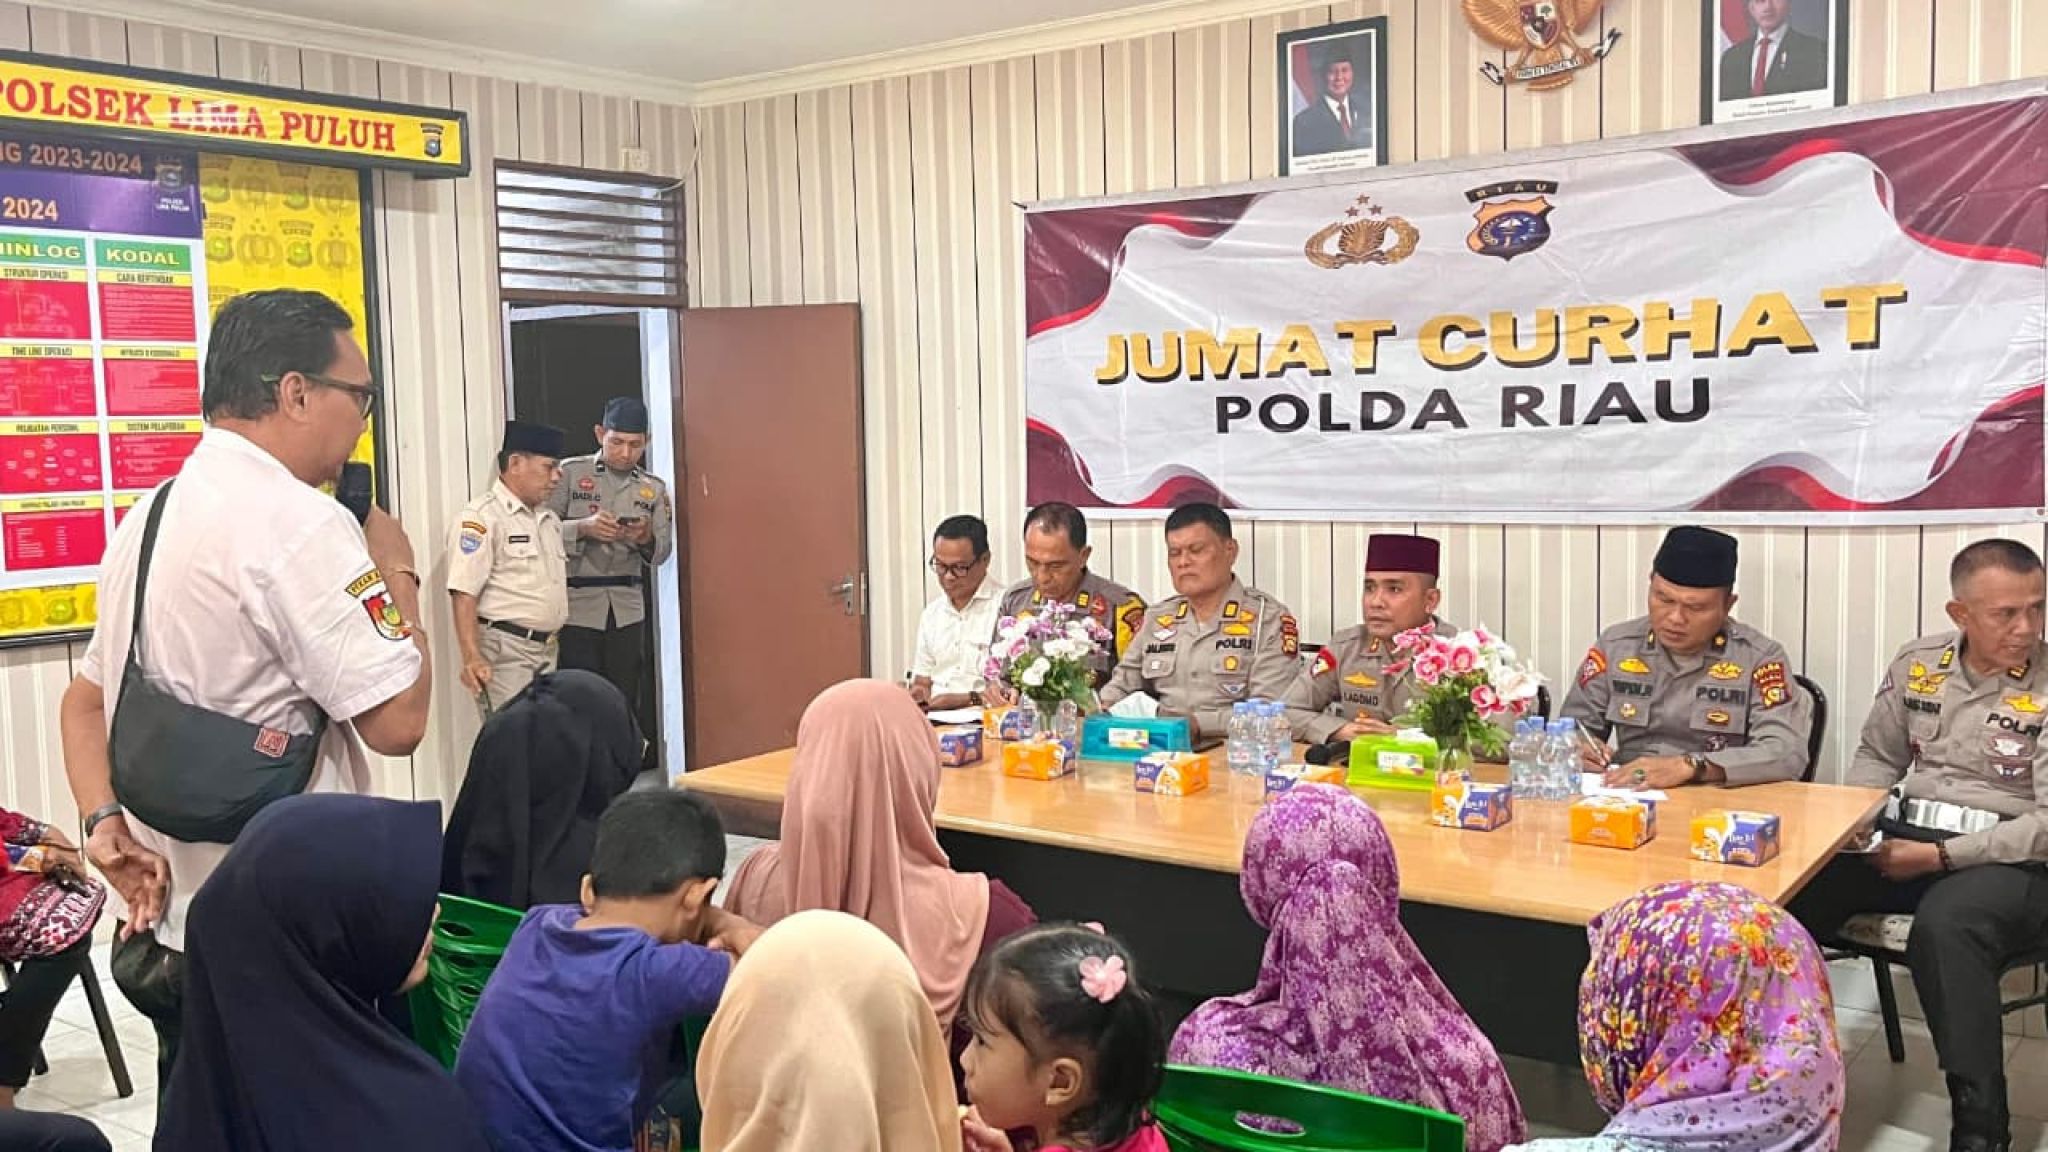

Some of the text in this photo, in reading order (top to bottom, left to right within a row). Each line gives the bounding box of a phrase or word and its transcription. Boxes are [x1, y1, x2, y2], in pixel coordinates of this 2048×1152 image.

[0, 77, 395, 152] OLSEK LIMA PULUH
[30, 143, 142, 174] 2023-2024
[1476, 183, 1546, 198] RIAU
[2, 196, 58, 221] 2024
[0, 242, 81, 259] INLOG
[106, 248, 180, 265] KODAL
[1094, 282, 1908, 385] JUMAT CURHAT
[1216, 377, 1711, 434] POLDA RIAU
[1216, 638, 1251, 650] POLRI
[1696, 686, 1746, 705] POLRI
